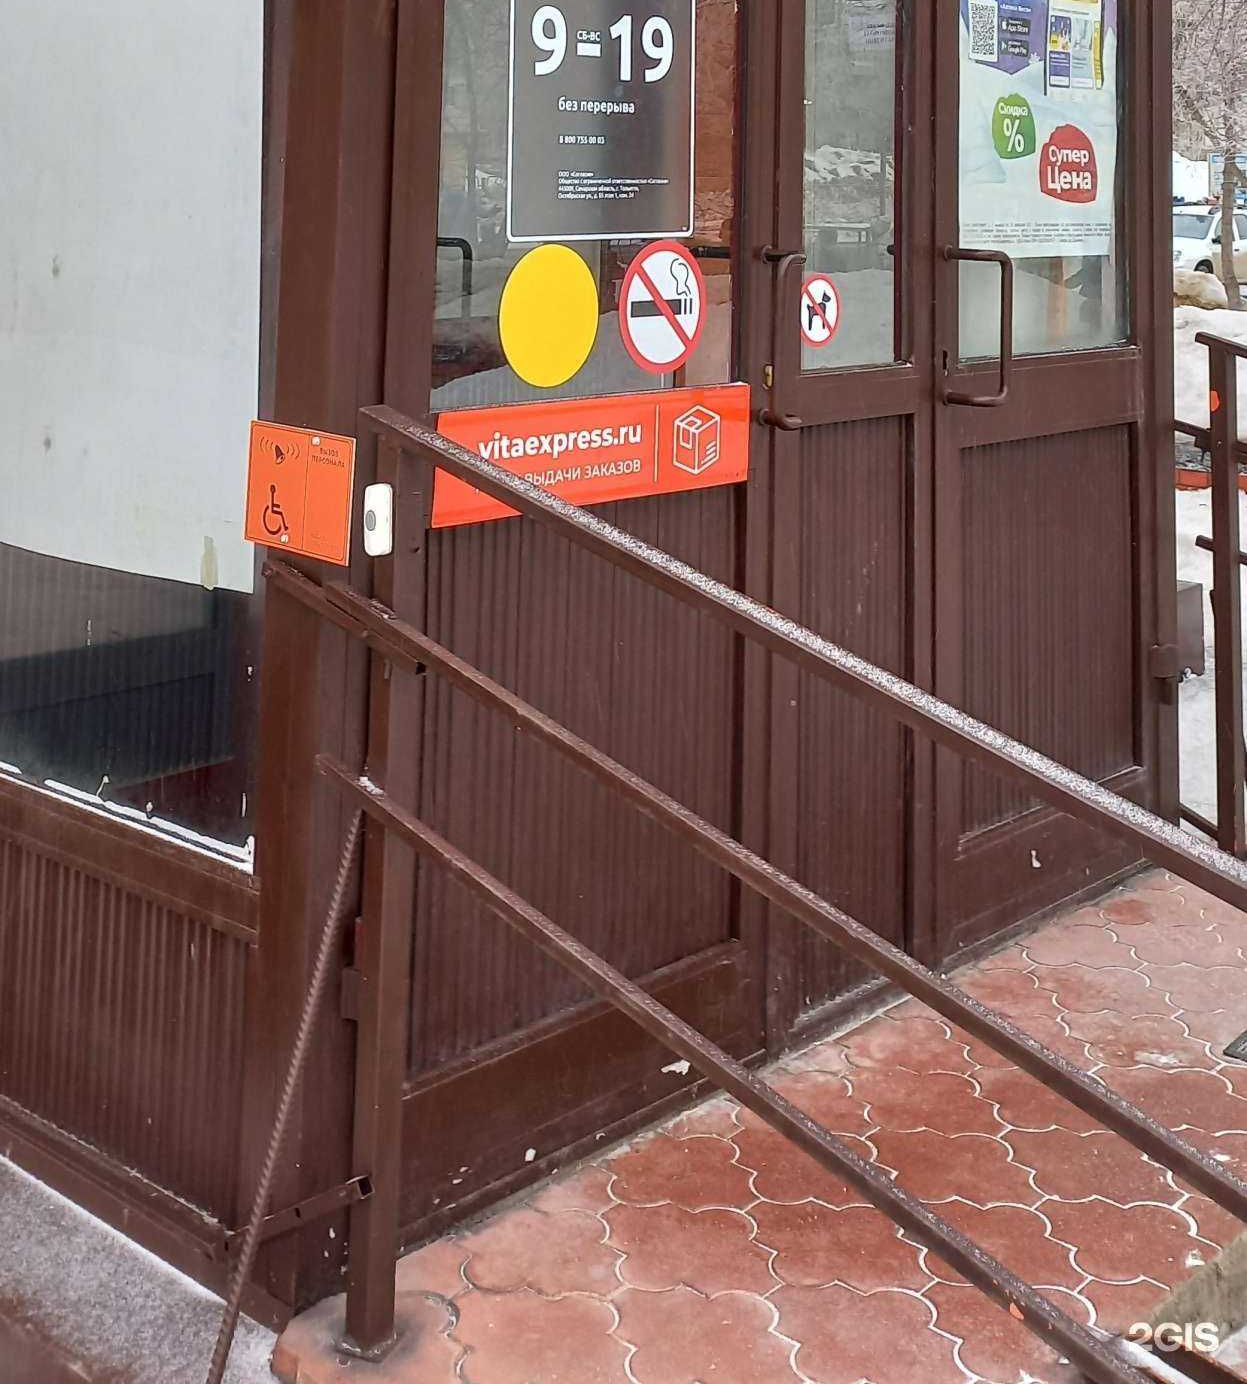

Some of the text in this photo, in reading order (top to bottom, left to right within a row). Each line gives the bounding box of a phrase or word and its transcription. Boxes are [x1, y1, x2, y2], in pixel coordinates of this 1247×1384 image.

[576, 30, 601, 42] СБ-ВС
[558, 96, 635, 115] без перерыва
[1049, 145, 1089, 164] Супер
[1047, 165, 1093, 192] Цена
[478, 424, 642, 460] vitaexpress.ru
[524, 459, 641, 487] ВЫДАЧИ ЗАКАЗОВ
